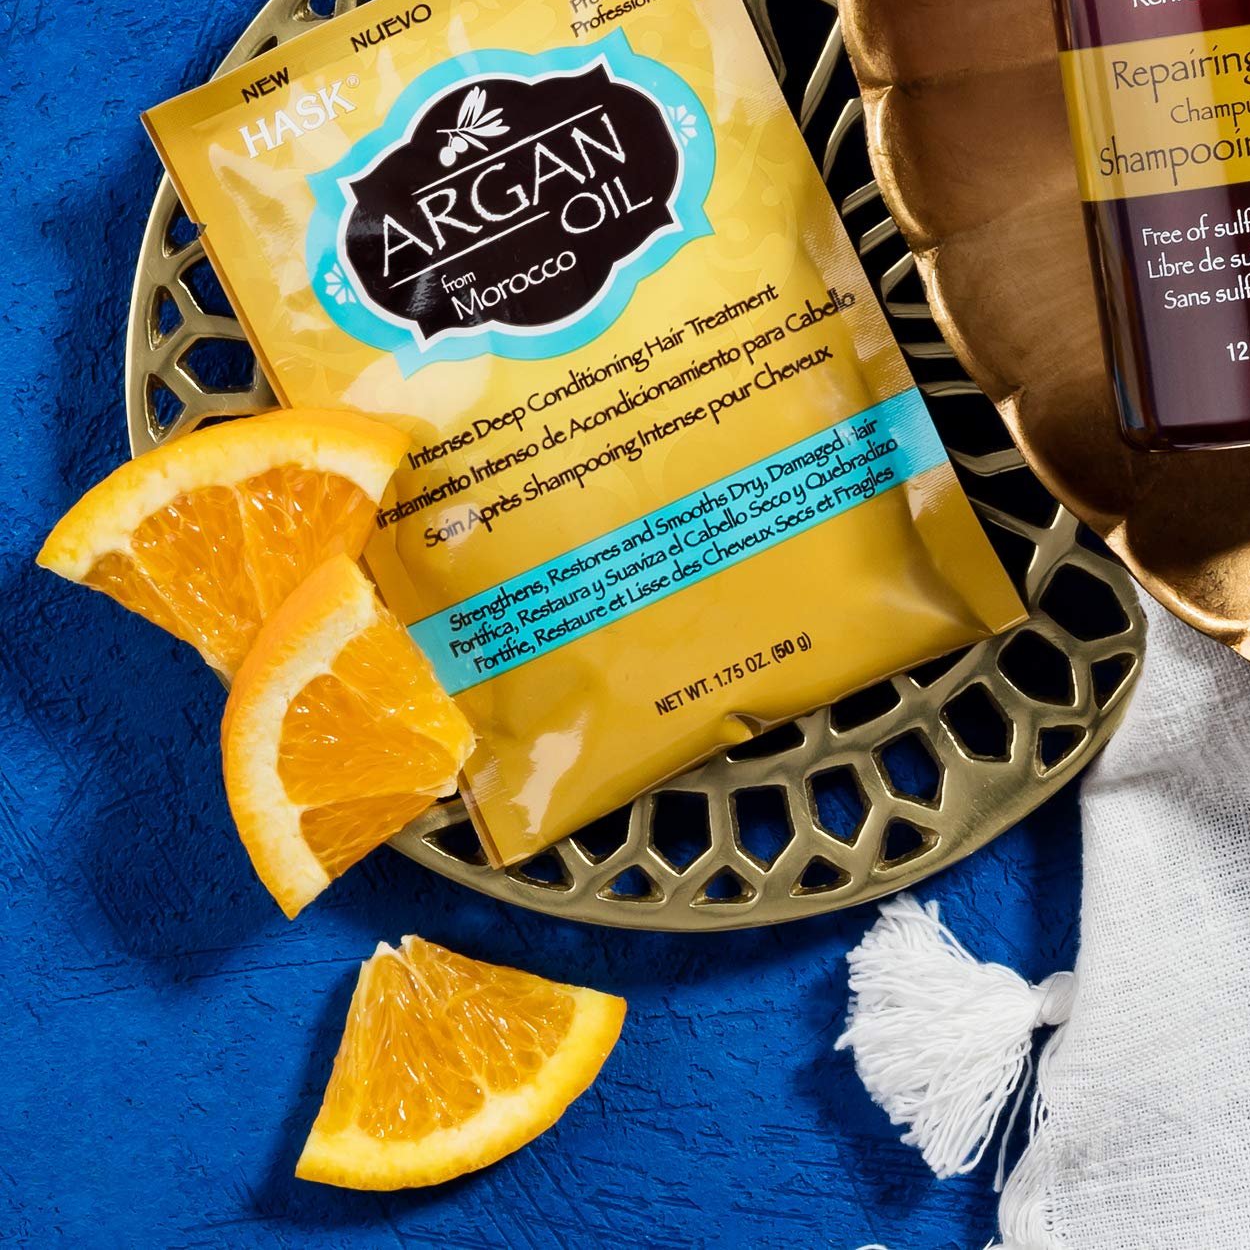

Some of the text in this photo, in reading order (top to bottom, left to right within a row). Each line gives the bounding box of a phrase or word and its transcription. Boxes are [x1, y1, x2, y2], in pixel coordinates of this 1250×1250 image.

[241, 67, 289, 103] NEW
[351, 4, 431, 52] NUEVO
[383, 113, 625, 277] ARGAN
[561, 177, 652, 234] OIL
[1142, 228, 1182, 246] Free
[1187, 214, 1209, 241] of
[441, 272, 476, 293] from
[451, 251, 576, 320] Morocco
[1148, 252, 1194, 278] Libre
[1199, 247, 1225, 272] de
[1165, 290, 1210, 309] Sans
[408, 284, 778, 470] Intense Deep Conditioning Hair Treatment
[1227, 342, 1249, 361] 12
[424, 346, 833, 547] Soin Après Shampooing Intense pour Cheveux
[470, 327, 785, 483] Intenso de Acondicionamiento para
[449, 439, 898, 658] Fortifica, Restaura Suaviza Cabello Seco Quebradizo
[450, 429, 844, 631] Strengthens, Restores and Smooths Dry, Damaged
[473, 467, 894, 673] Fortifie, Restaure Lisse Cheveux Secs Fragiles
[655, 632, 811, 715] NET WT. 1.75 OZ. (50 g)
